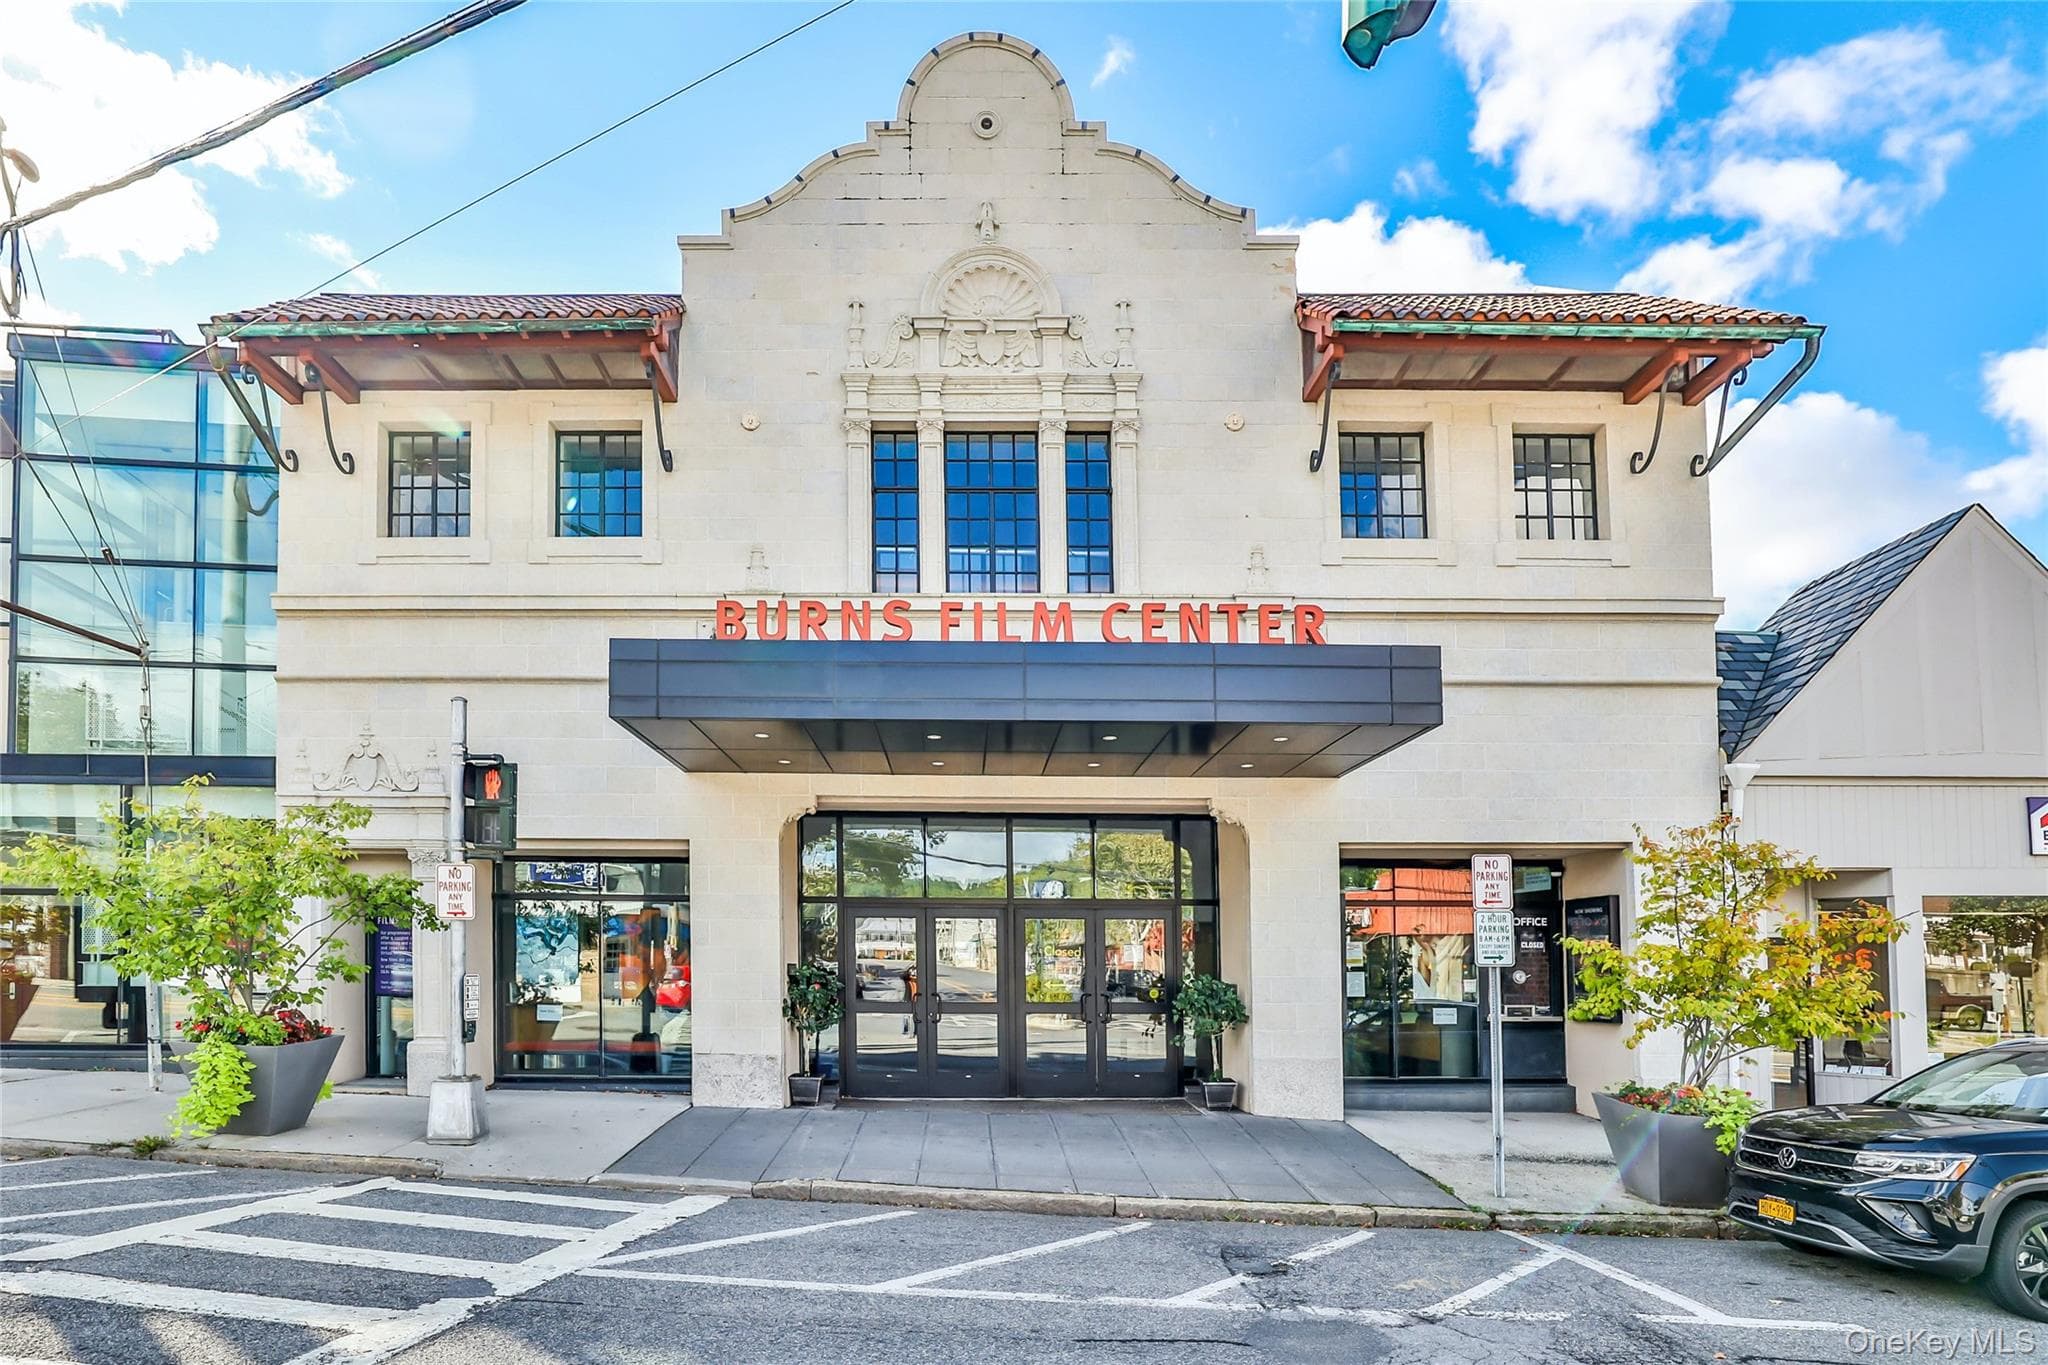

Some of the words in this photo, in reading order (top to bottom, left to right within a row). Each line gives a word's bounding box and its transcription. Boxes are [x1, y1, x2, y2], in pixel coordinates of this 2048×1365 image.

[716, 600, 913, 641] BURNS
[940, 601, 1074, 643] FILM
[1101, 602, 1328, 645] CENTER
[1484, 860, 1498, 869] NO
[448, 869, 462, 879] NO
[1476, 871, 1508, 881] PARKING
[439, 881, 472, 892] PARKING
[448, 903, 464, 911] TIME
[1513, 918, 1547, 926] OFFICE
[1044, 945, 1081, 957] Closed
